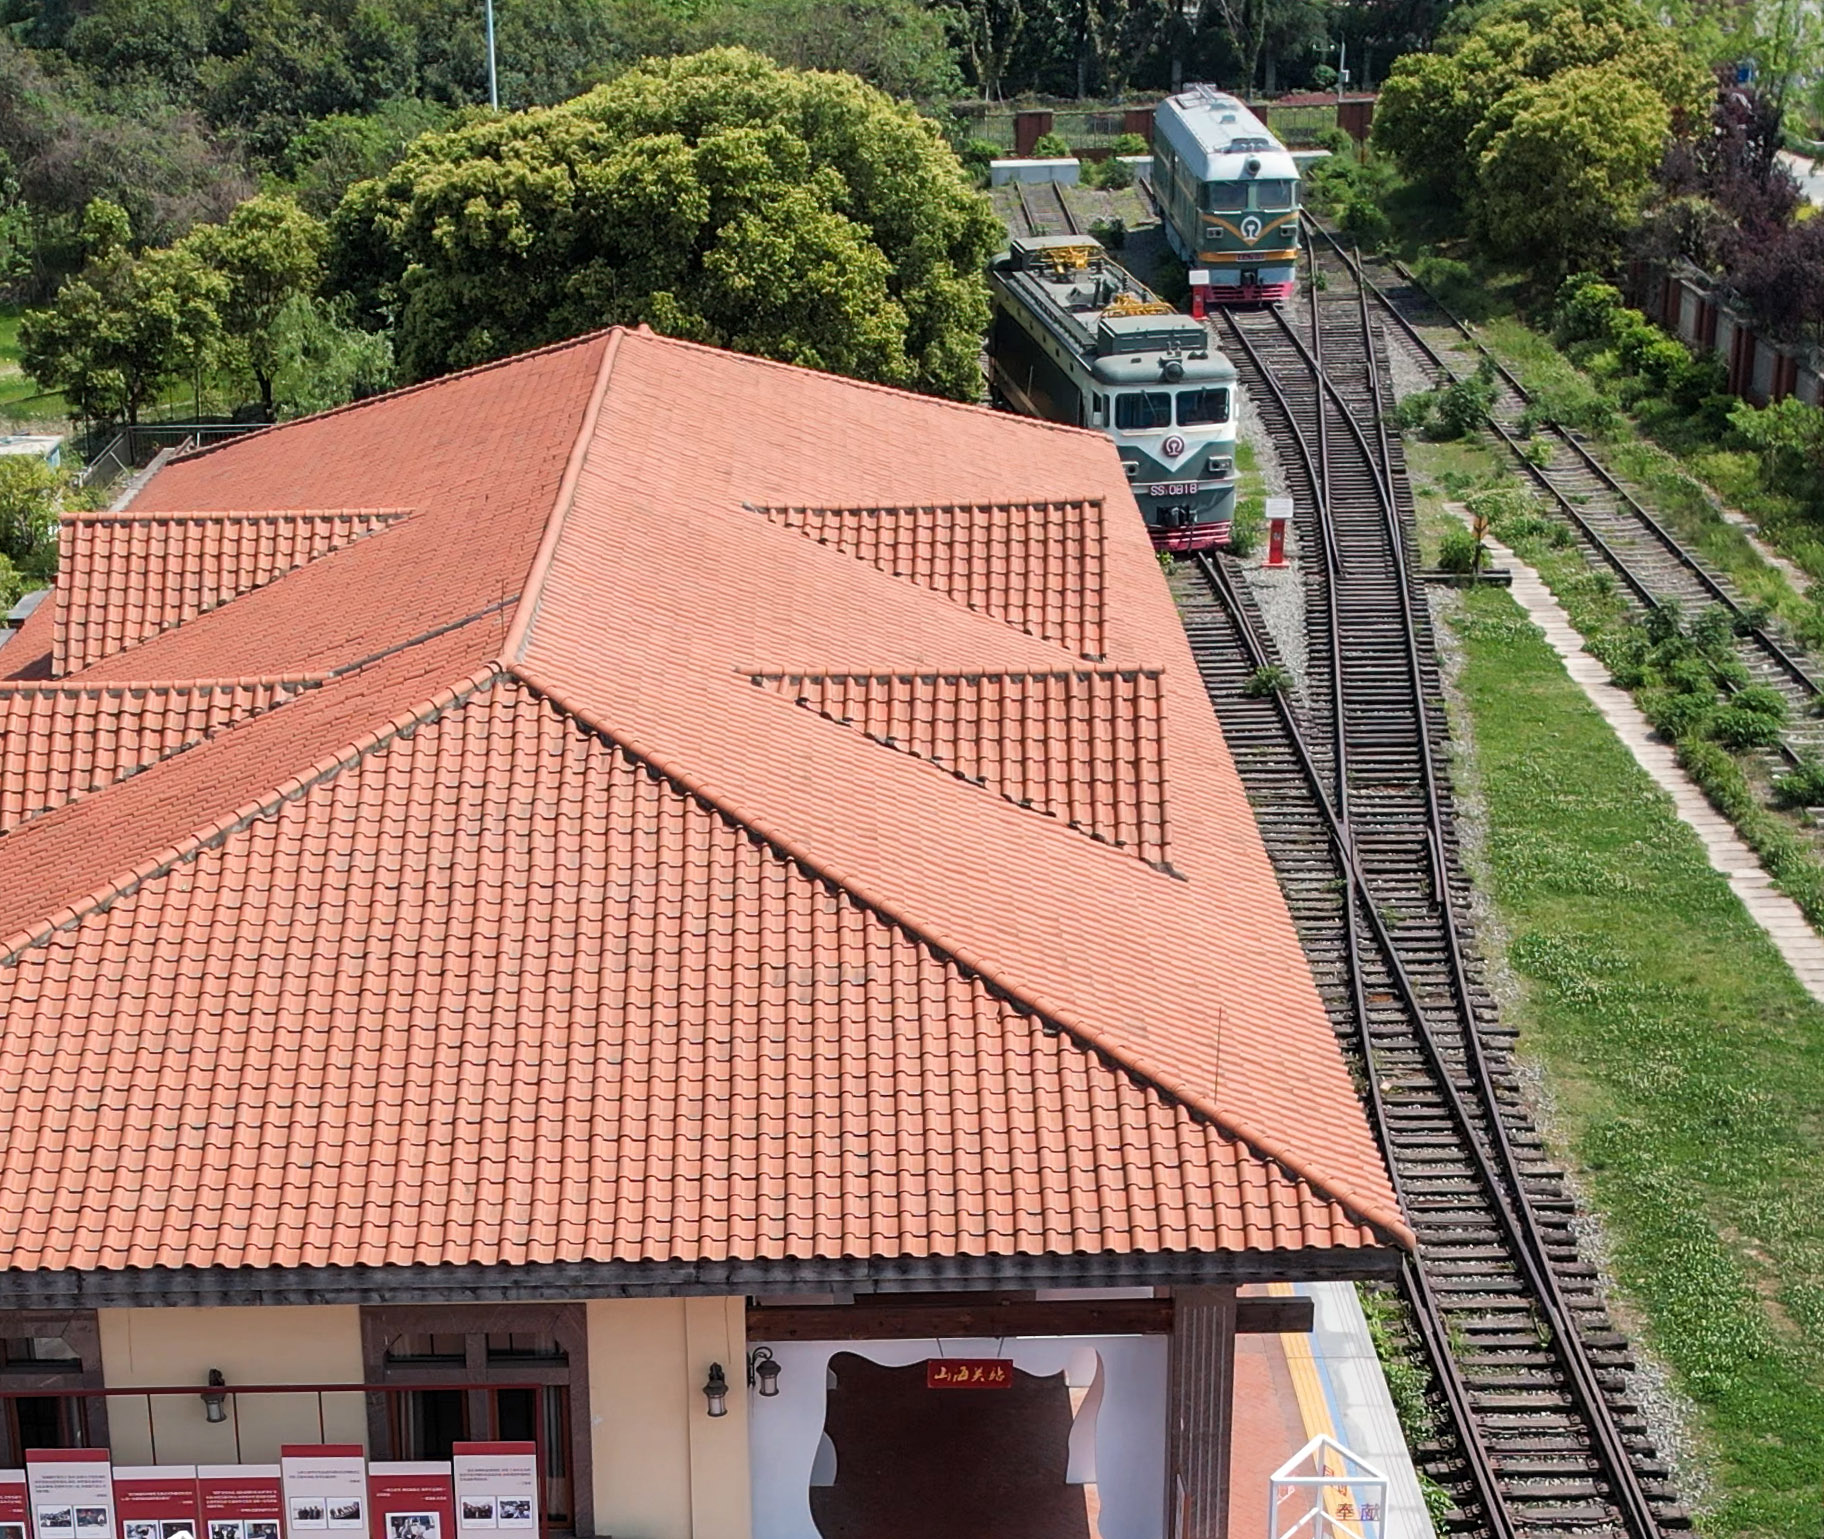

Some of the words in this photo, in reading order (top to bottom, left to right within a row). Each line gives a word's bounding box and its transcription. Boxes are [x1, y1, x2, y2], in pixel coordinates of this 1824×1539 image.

[934, 1366, 1006, 1382] 山海关站
[1336, 1503, 1381, 1521] 奉献
